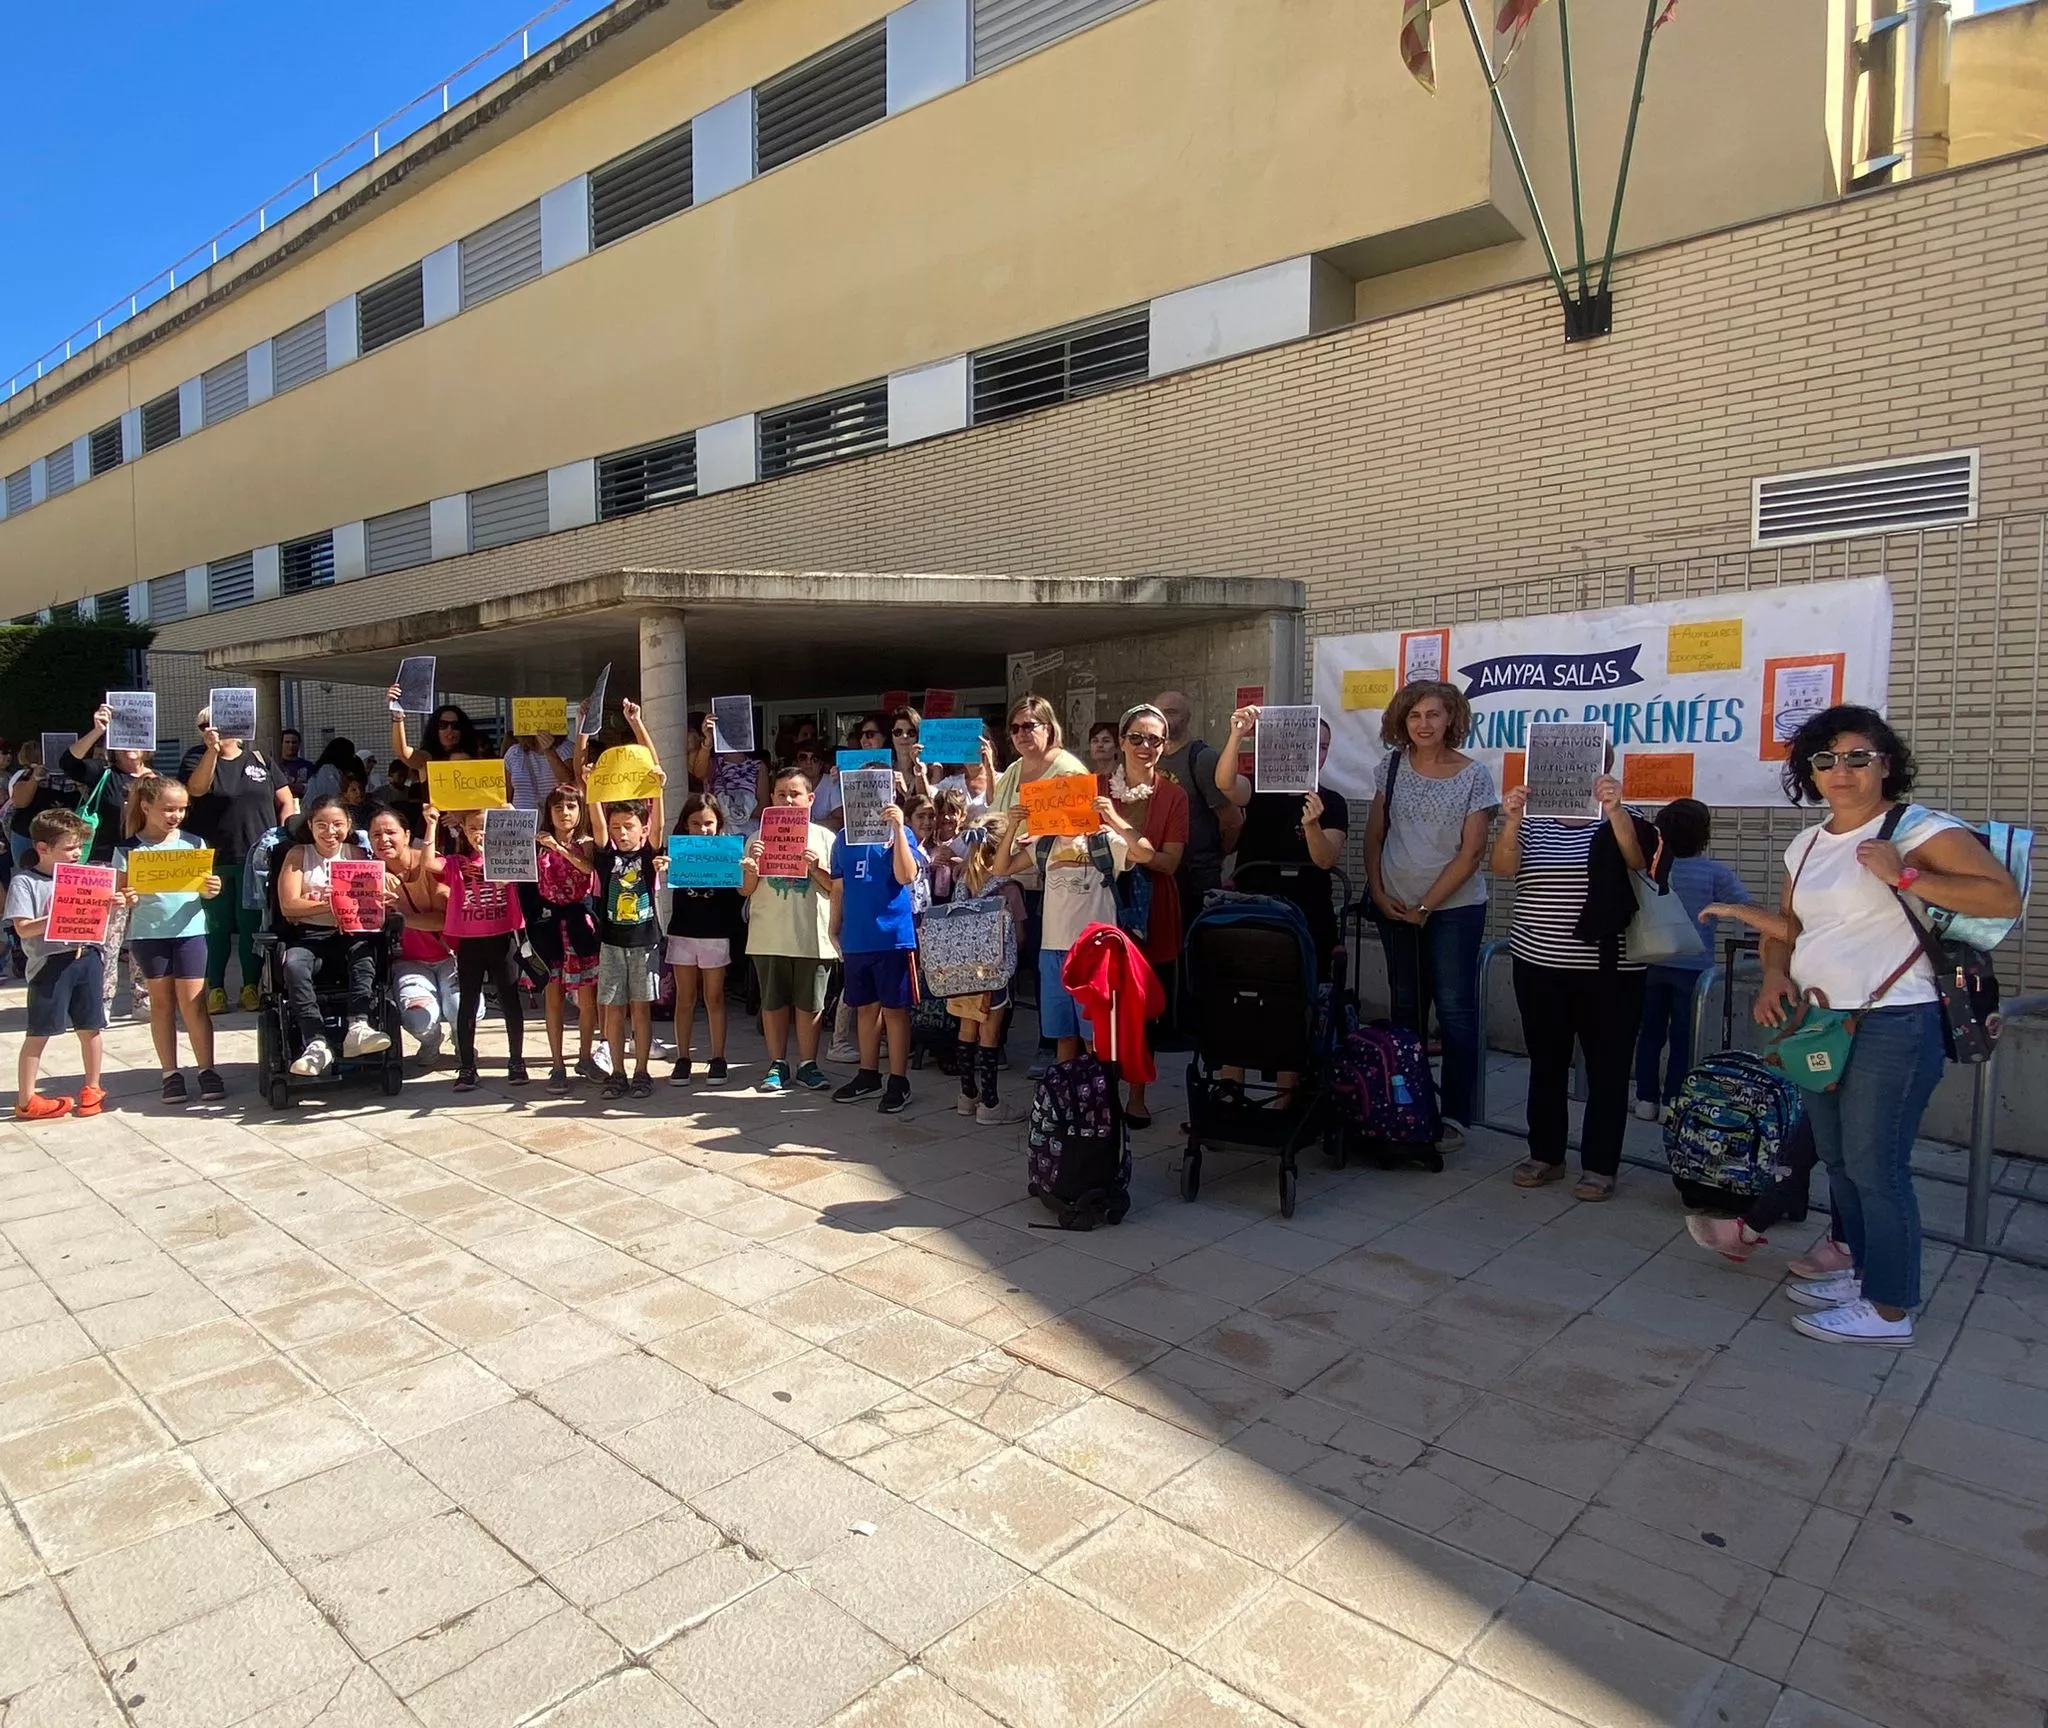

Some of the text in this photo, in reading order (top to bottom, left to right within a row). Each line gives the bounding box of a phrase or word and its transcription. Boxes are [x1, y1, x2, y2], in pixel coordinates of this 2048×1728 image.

[1481, 659, 1620, 686] AMYPA SALAS
[1260, 718, 1316, 729] ESTAMOS
[1280, 731, 1295, 739] SIN
[1531, 735, 1602, 748] ESTAMOS
[1556, 751, 1575, 760] SIN
[1534, 763, 1598, 773] AUXILIARES
[433, 768, 507, 791] + RECURSOS
[593, 769, 657, 786] RECORTES
[844, 780, 890, 791] ESTAMOS
[1055, 780, 1069, 790] LA
[1538, 800, 1587, 809] ESPECIAL
[486, 819, 534, 828] ESTAMOS
[763, 816, 807, 825] ESTAMOS
[1061, 817, 1091, 828] JEGA
[676, 837, 719, 849] FALTA
[136, 849, 212, 864] AUXILIARES
[676, 852, 740, 864] PERSONAL
[332, 870, 382, 880] ESTAMOS
[854, 860, 867, 879] 9
[56, 874, 113, 888] ESTAMOS
[57, 896, 110, 907] AUXILIARES
[461, 907, 508, 921] TIGERS
